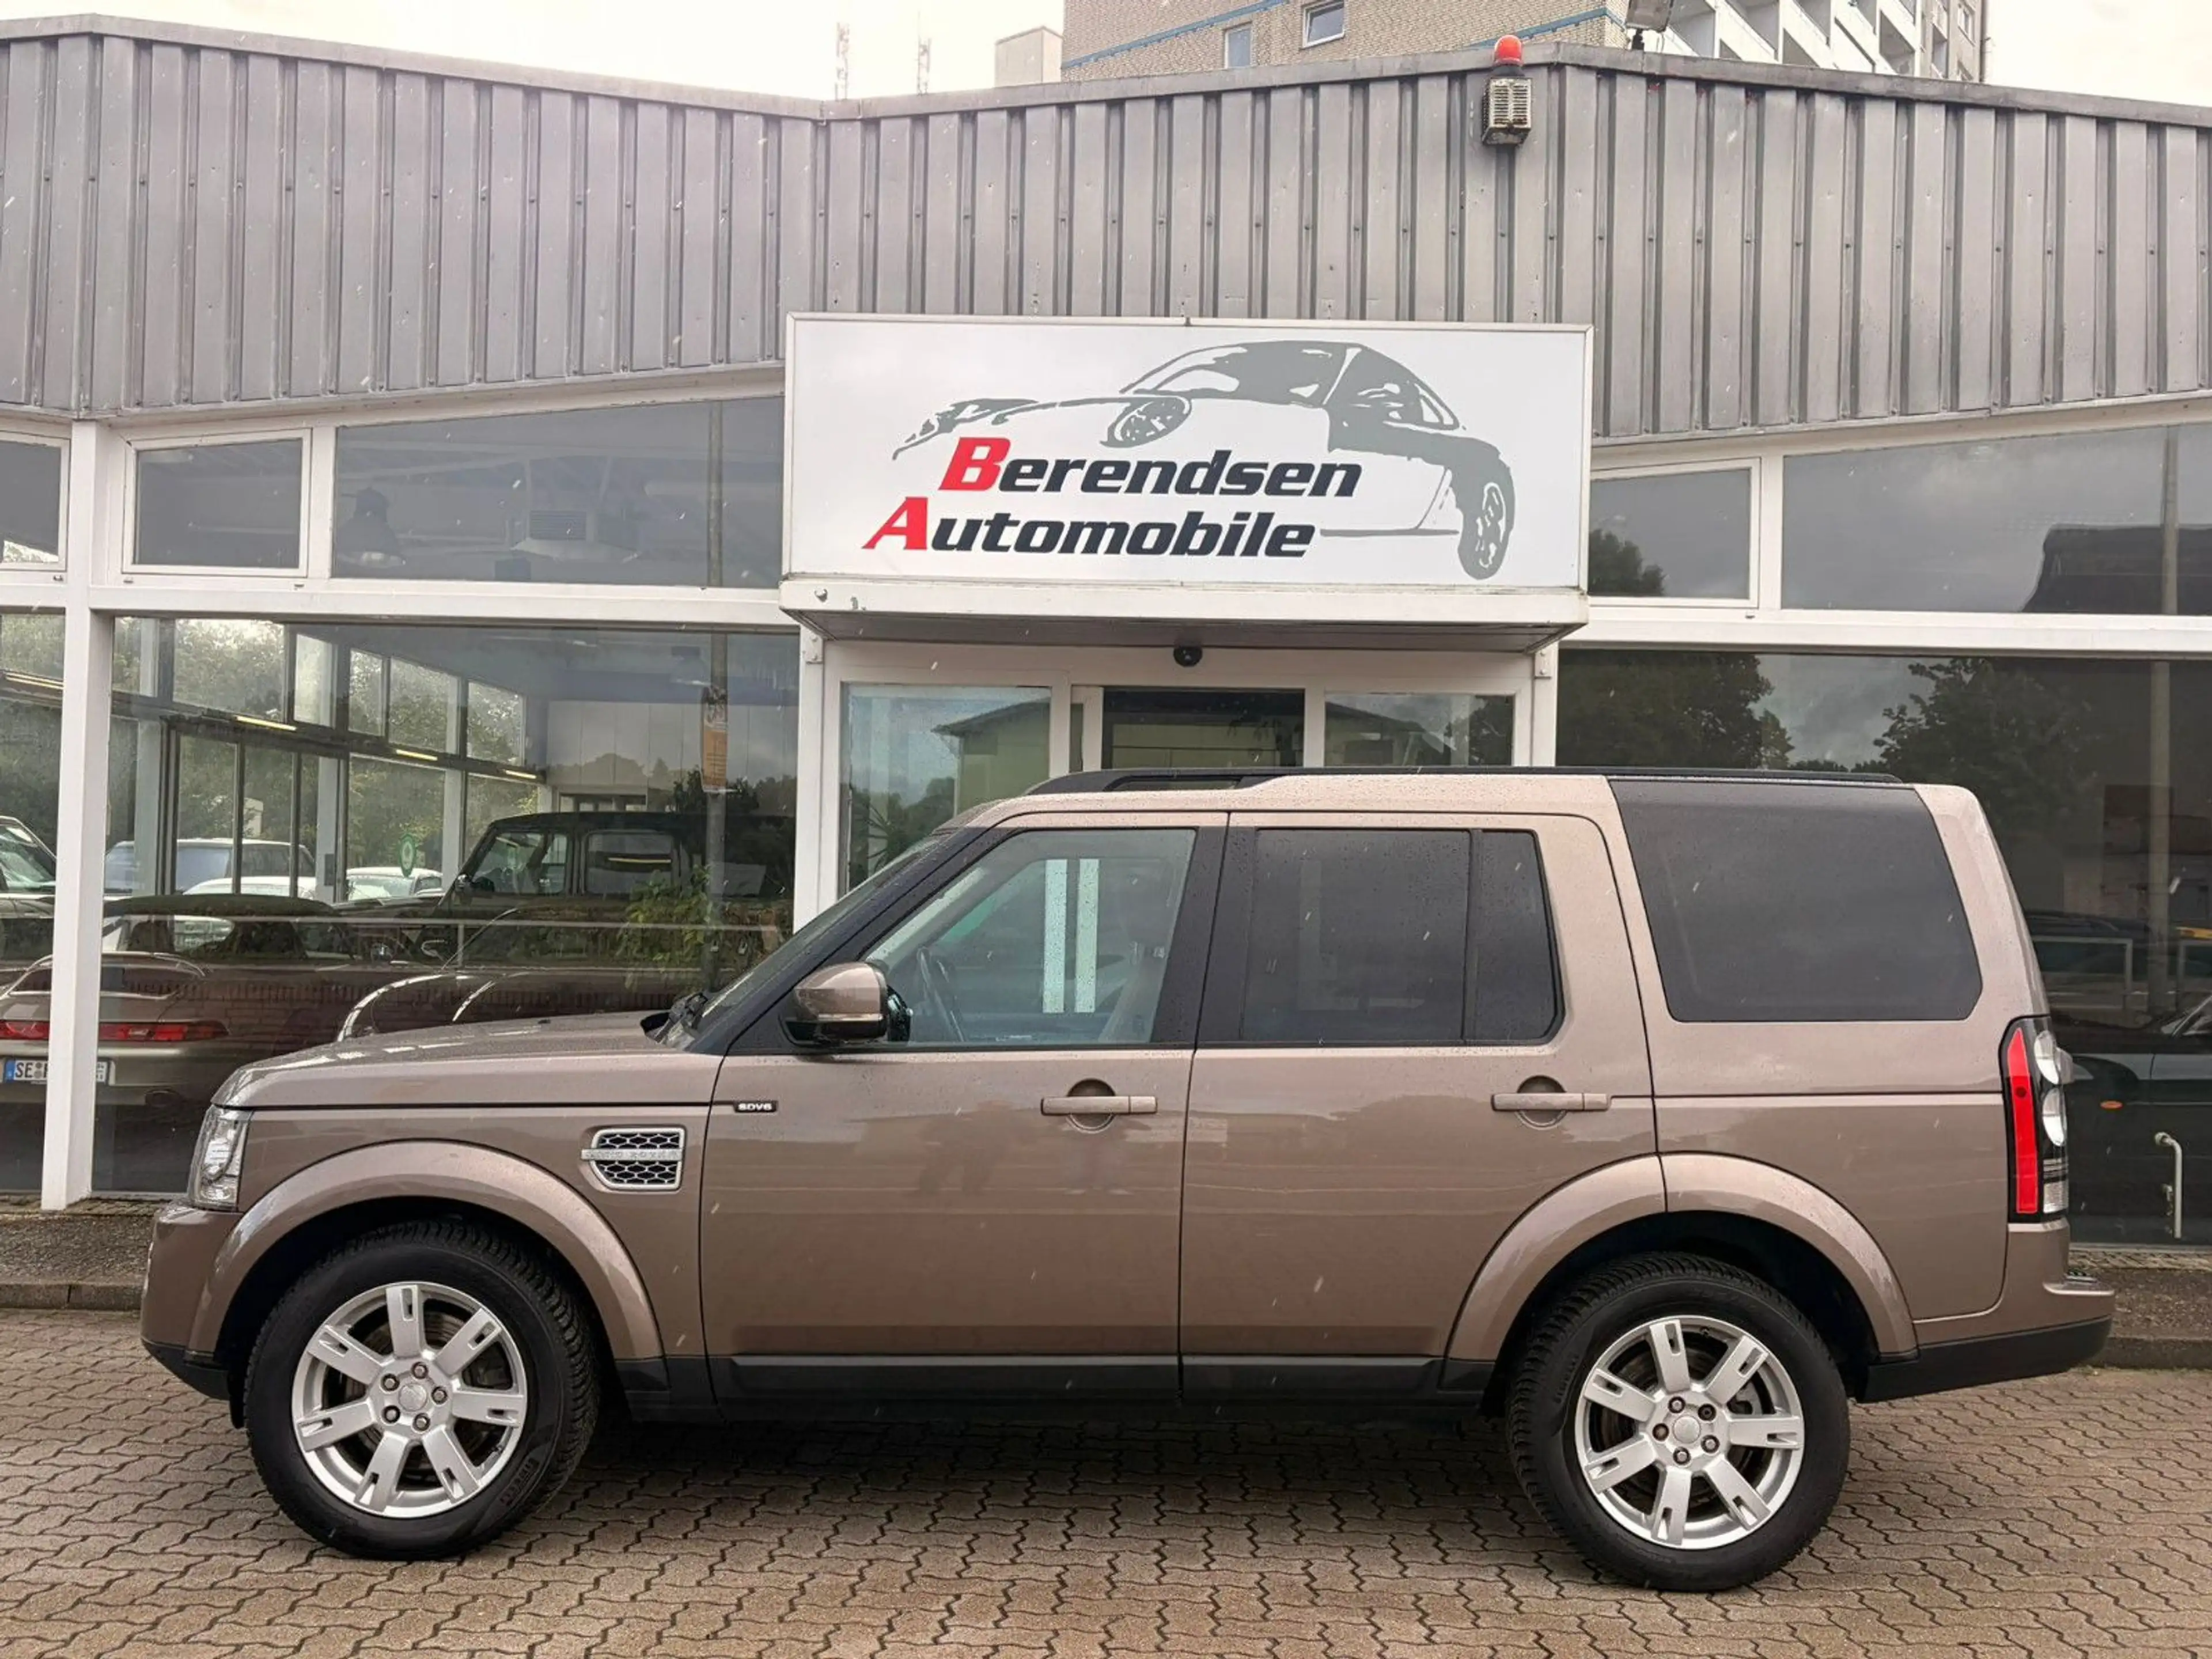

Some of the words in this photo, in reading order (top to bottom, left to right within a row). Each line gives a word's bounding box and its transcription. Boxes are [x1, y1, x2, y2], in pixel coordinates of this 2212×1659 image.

[939, 437, 1362, 497] Berendsen
[862, 497, 1316, 558] Automobile
[15, 1062, 33, 1078] SE
[738, 1103, 772, 1111] SDV6
